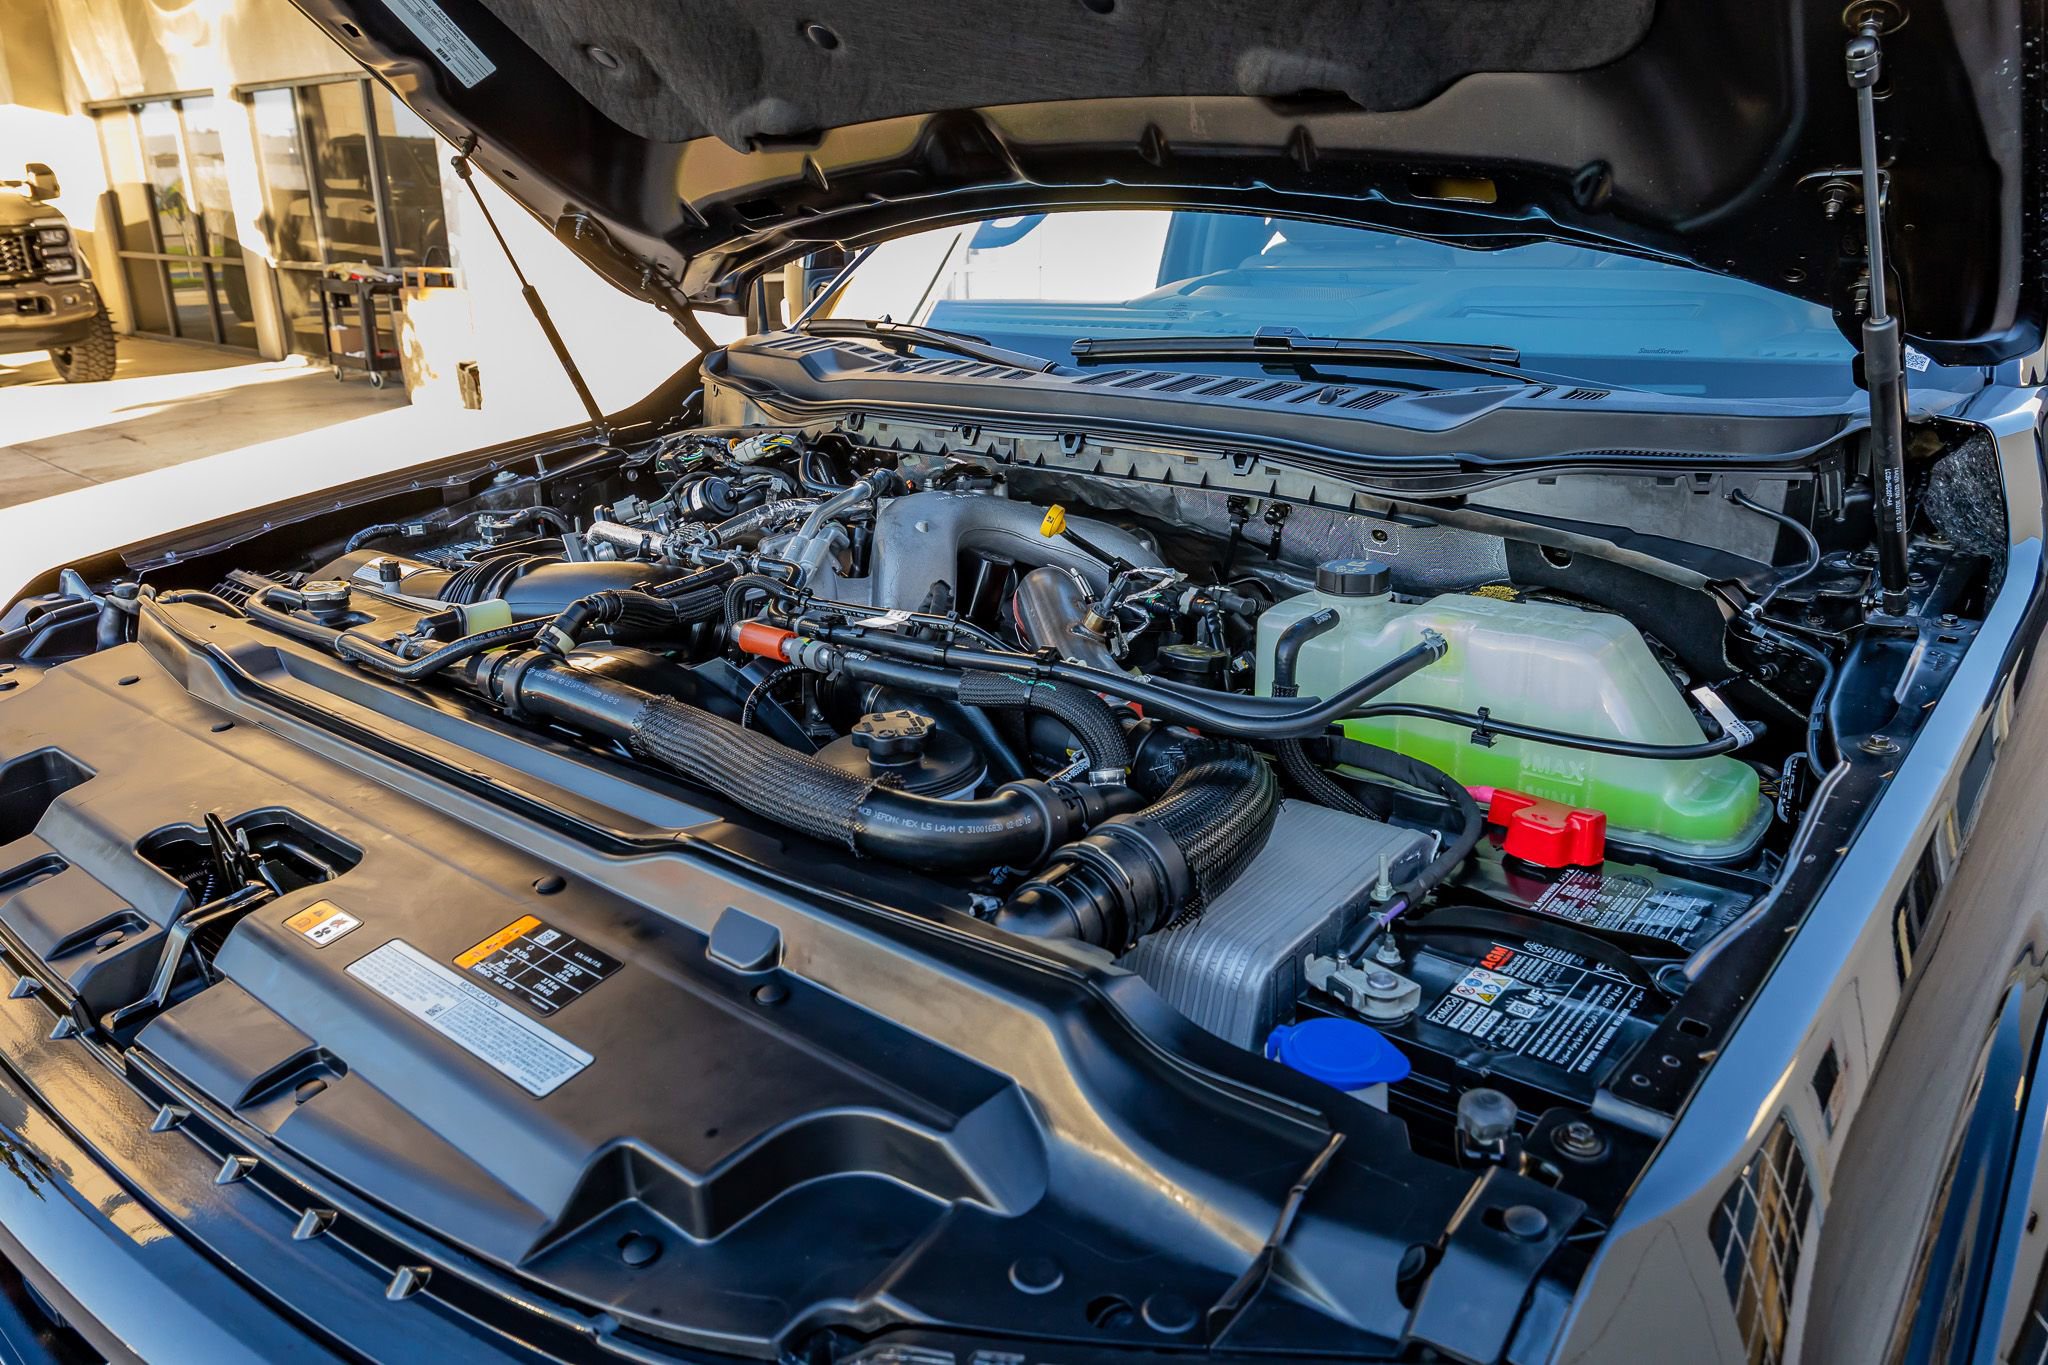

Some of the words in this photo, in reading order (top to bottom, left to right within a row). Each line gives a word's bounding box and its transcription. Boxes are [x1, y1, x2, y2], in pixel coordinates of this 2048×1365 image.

[1480, 946, 1509, 970] AGM
[459, 981, 500, 1008] MODIFICATION
[1431, 996, 1460, 1022] FoMoCo
